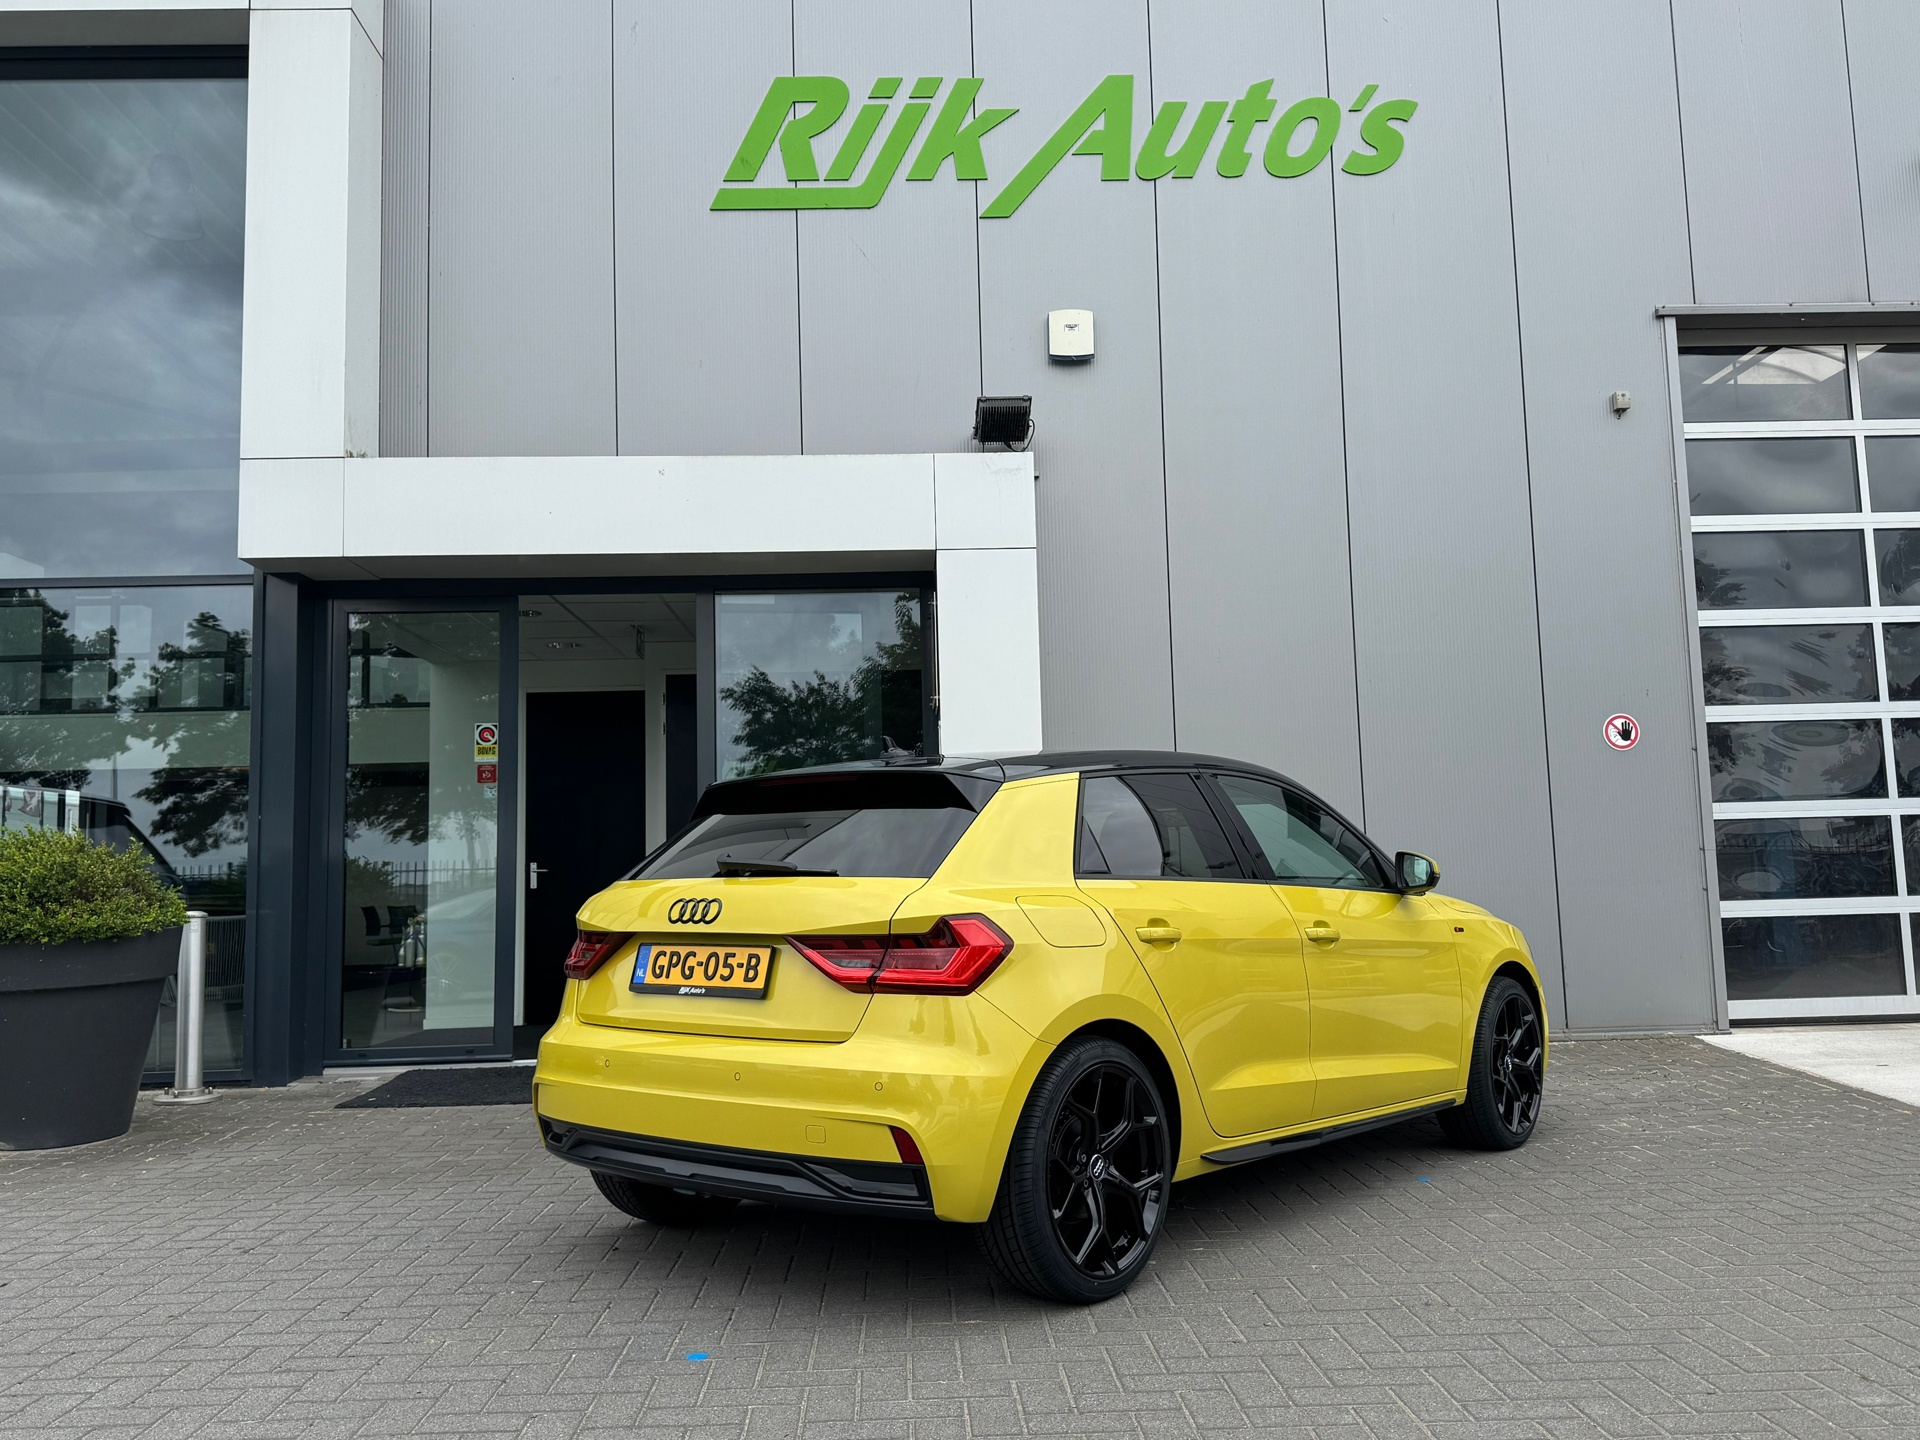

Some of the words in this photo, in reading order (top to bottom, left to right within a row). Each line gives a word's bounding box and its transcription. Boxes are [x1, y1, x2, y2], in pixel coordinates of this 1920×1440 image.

[710, 76, 1019, 211] Rijk
[980, 74, 1418, 218] Auto's
[478, 746, 496, 755] BOVAG
[636, 968, 645, 977] NL
[651, 950, 760, 982] GPG-05-B
